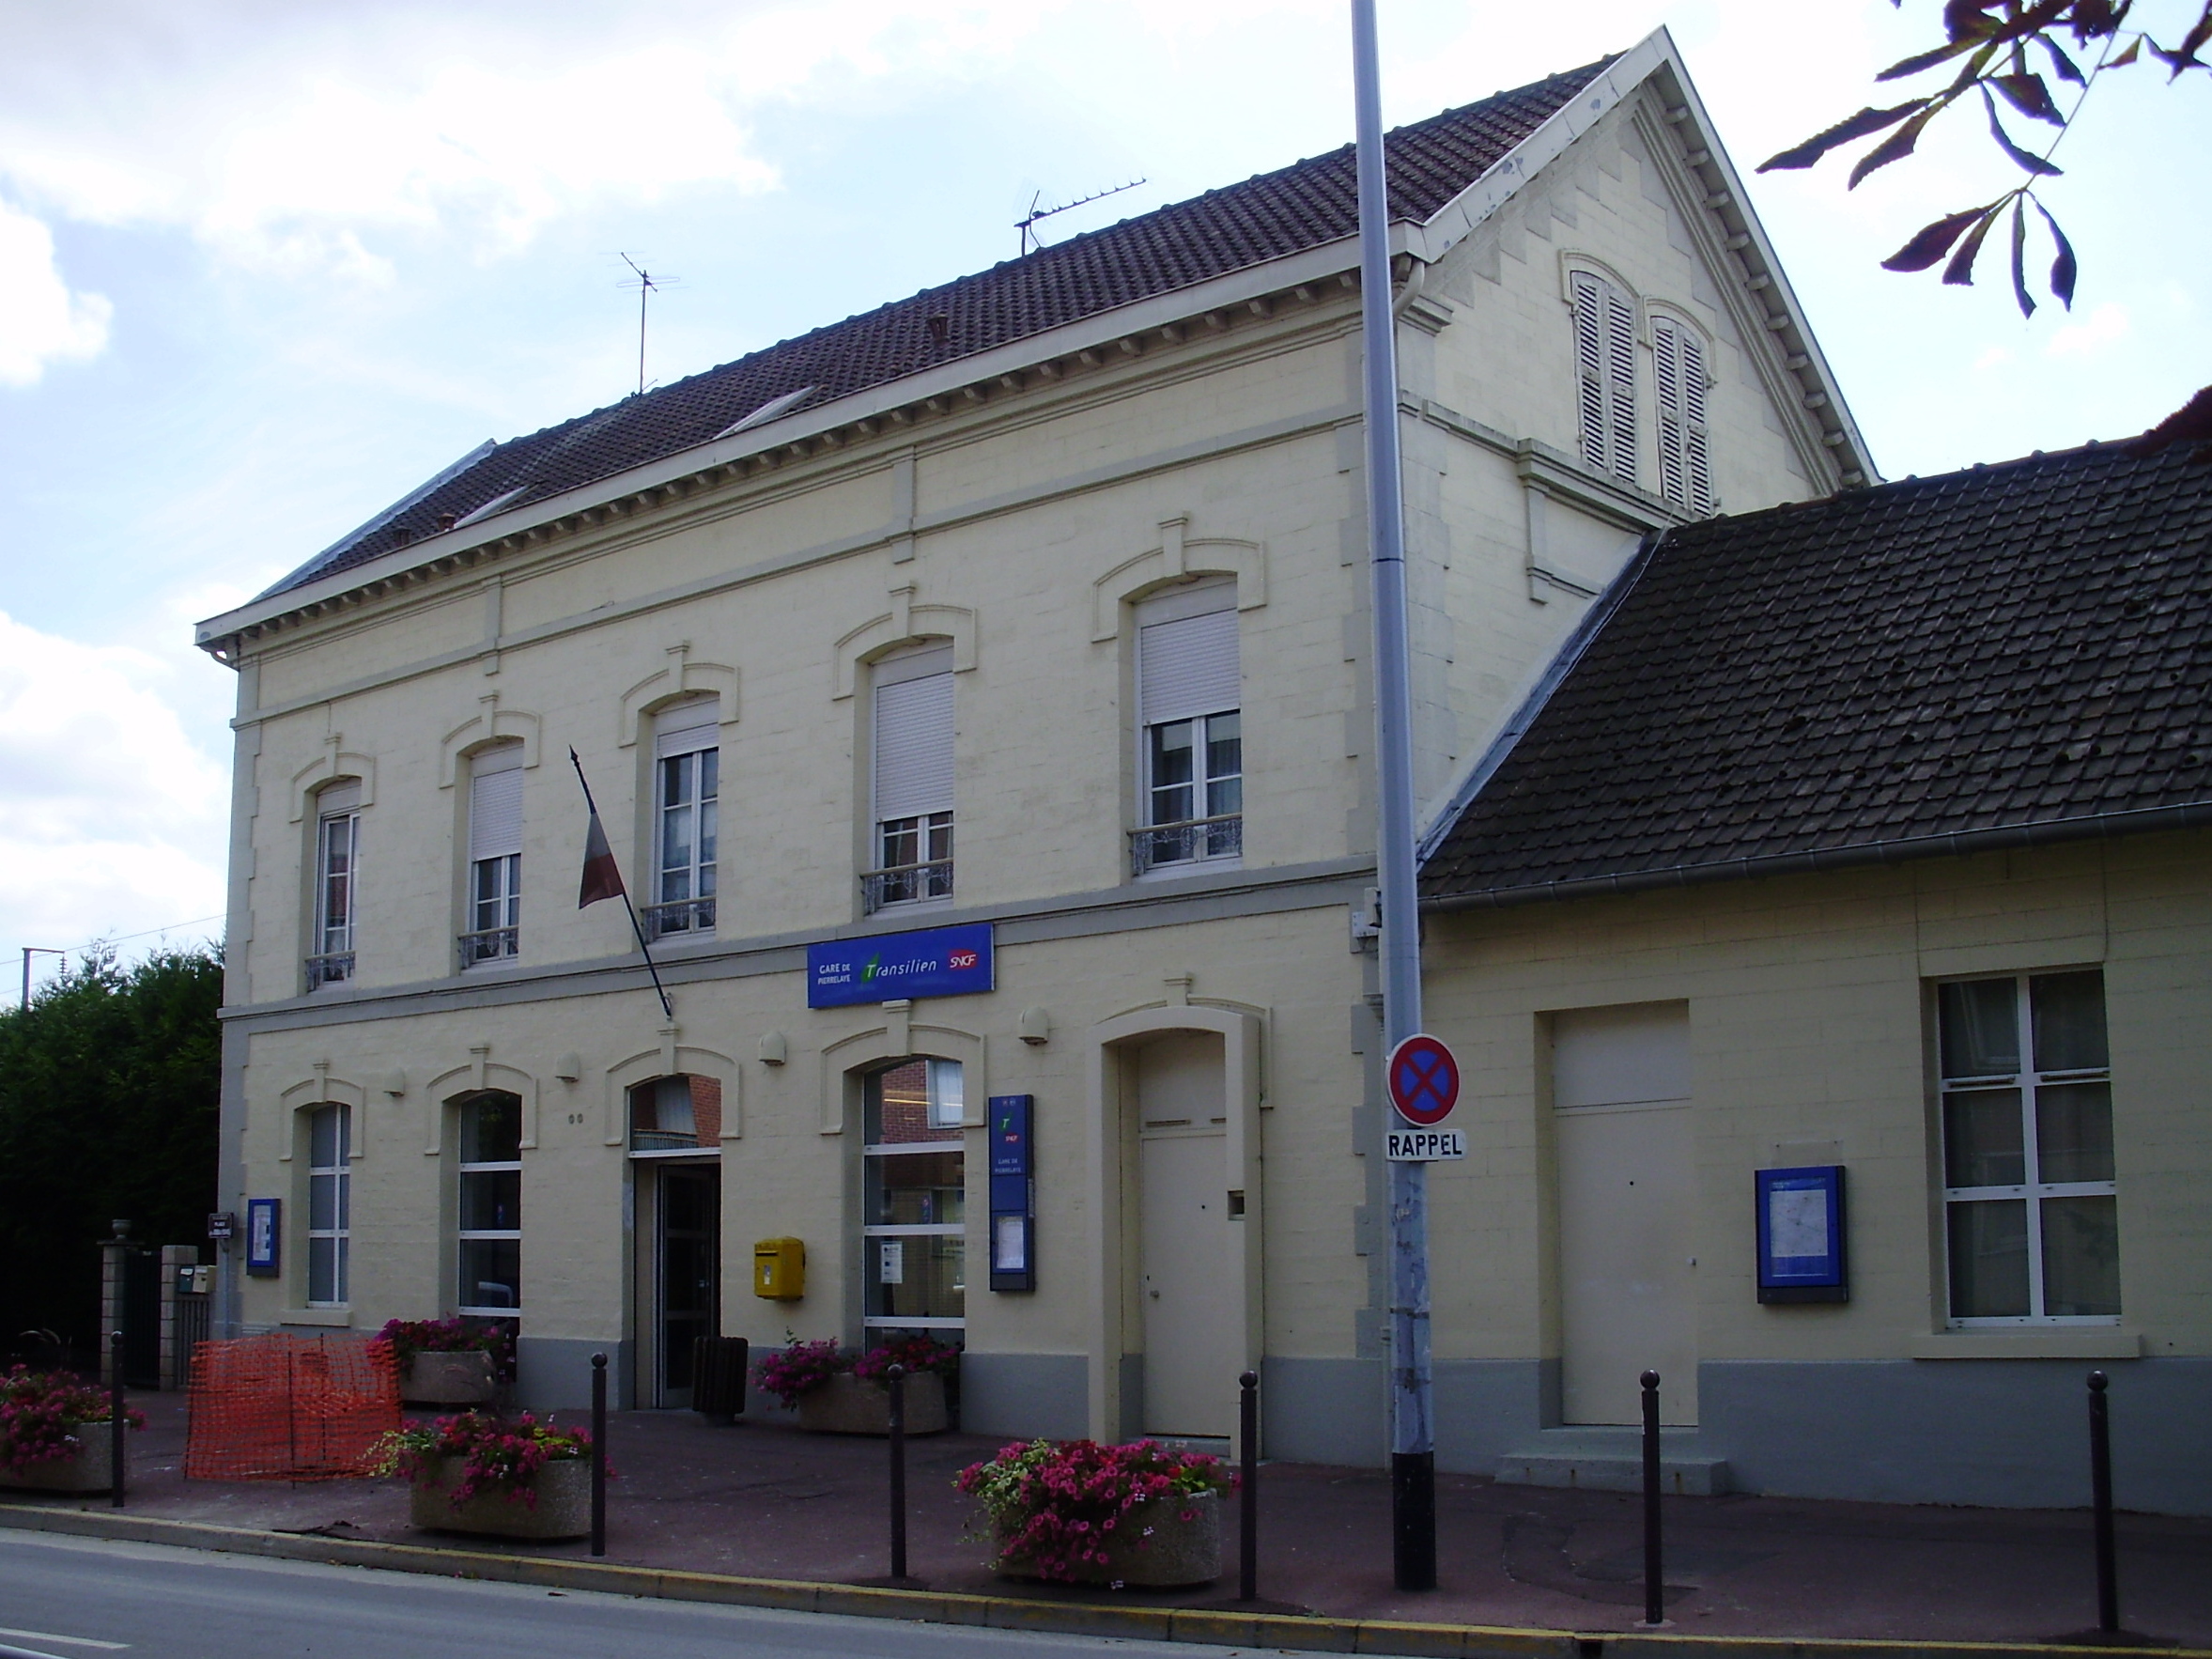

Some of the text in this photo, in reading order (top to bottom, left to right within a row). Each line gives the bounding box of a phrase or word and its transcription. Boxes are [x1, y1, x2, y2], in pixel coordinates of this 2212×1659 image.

[819, 963, 851, 974] GARE DE
[866, 958, 936, 978] Transilien
[950, 954, 977, 968] SNCF
[1388, 1134, 1462, 1156] RAPPEL
